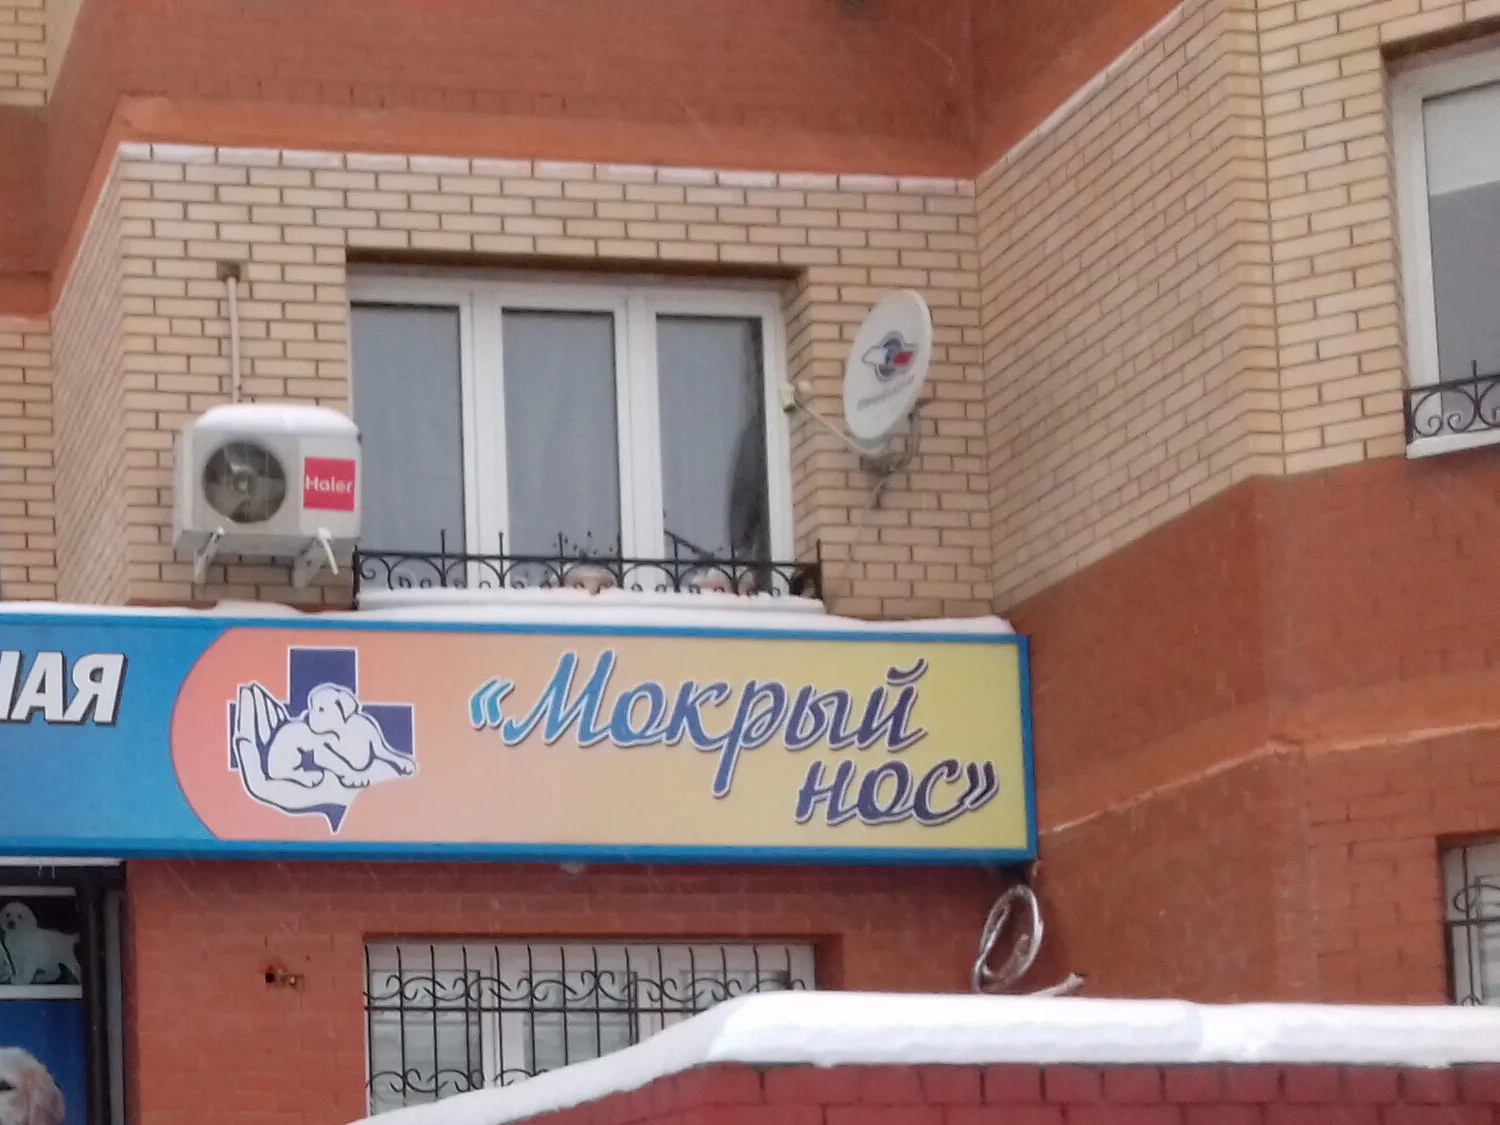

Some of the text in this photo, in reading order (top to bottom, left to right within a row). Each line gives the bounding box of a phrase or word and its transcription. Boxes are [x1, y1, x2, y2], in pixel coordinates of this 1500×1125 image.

[305, 475, 353, 494] Haier
[468, 649, 929, 798] «Мокрый
[794, 757, 1001, 827] нос»
